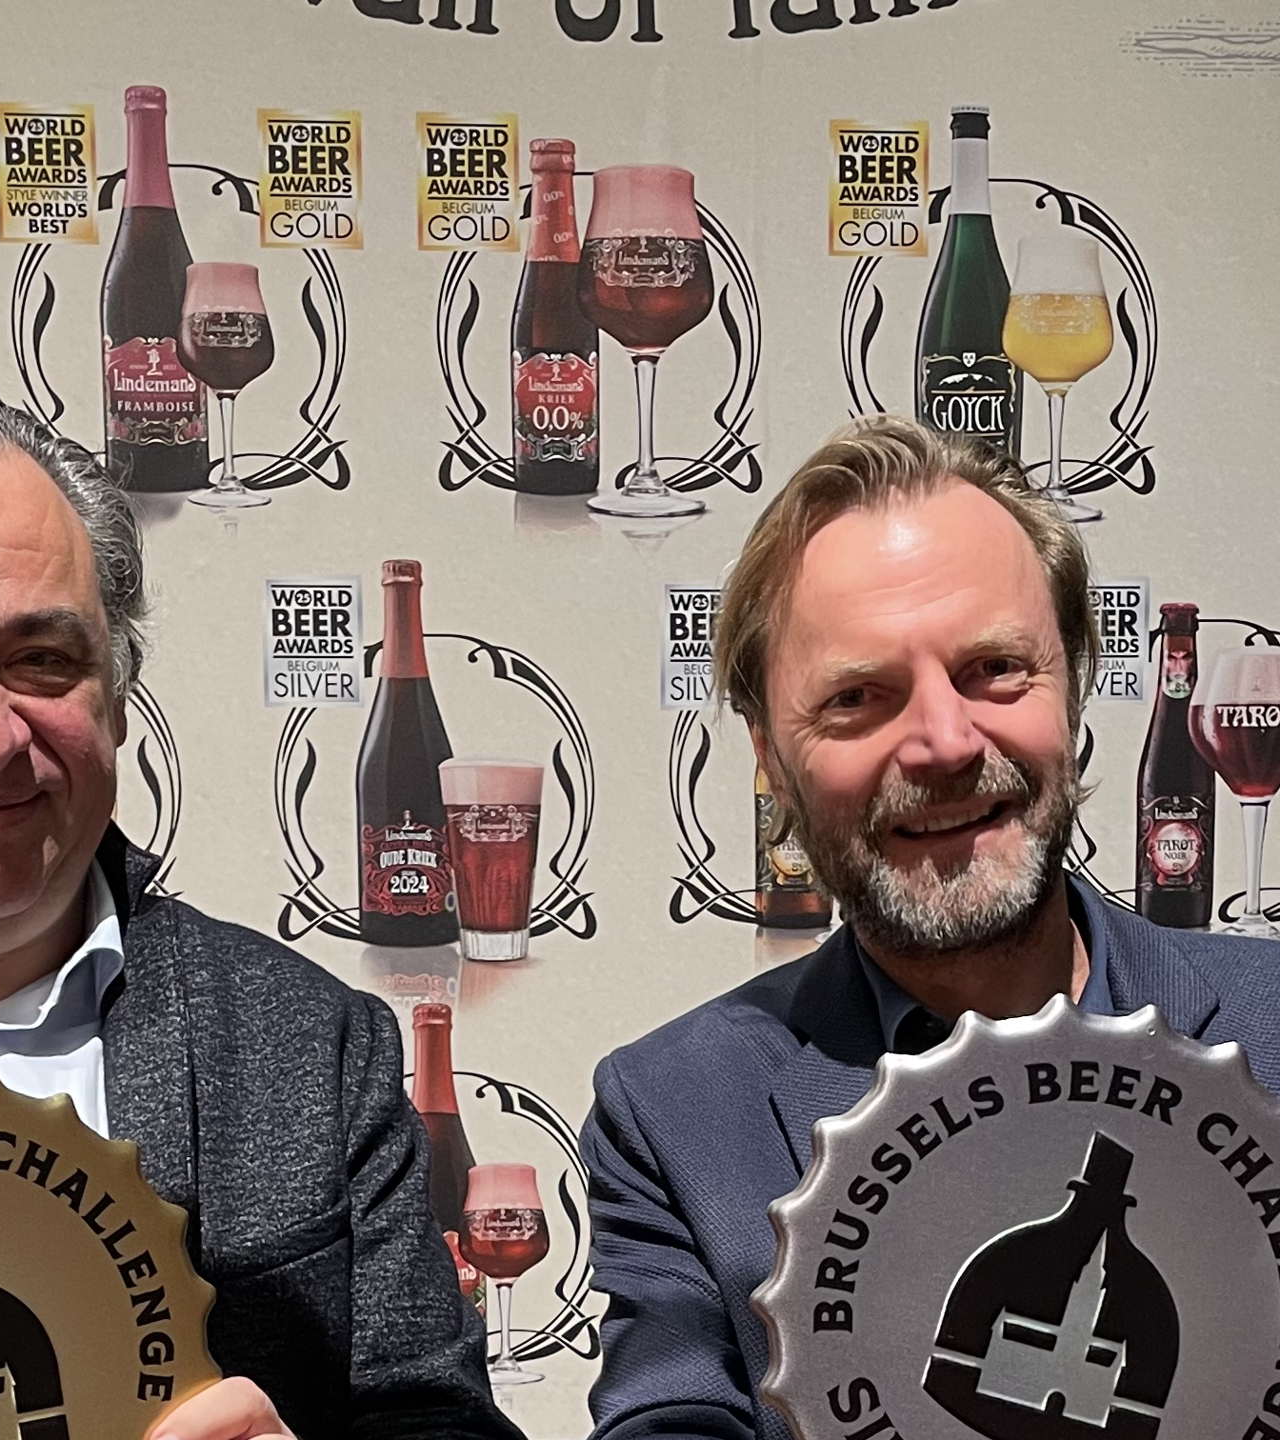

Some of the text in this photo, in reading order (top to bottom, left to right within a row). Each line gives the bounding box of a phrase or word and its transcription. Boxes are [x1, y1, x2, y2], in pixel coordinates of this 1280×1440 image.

[5, 118, 85, 136] WORLD
[268, 125, 351, 143] WORLD
[426, 128, 508, 146] WORLD
[840, 135, 919, 153] WORLD
[5, 137, 85, 166] BEER
[268, 145, 351, 175] BEER
[427, 148, 508, 178] BEER
[839, 155, 918, 184] BEER
[7, 168, 87, 183] AWARDS
[270, 176, 352, 193] AWARDS
[7, 190, 88, 202] STYLE WINNER
[427, 180, 509, 196] AWARDS
[839, 186, 919, 201] AWARDS
[8, 202, 87, 218] WORLD'S
[285, 200, 338, 211] BELGIUM
[442, 202, 496, 214] BELGIUM
[853, 208, 904, 219] BELGIUM
[29, 219, 69, 233] BEST
[270, 212, 353, 238] GOLD
[428, 215, 510, 241] GOLD
[839, 221, 918, 246] GOLD
[117, 401, 195, 412] FRAMBOISE
[932, 395, 1005, 432] GOYCK
[271, 589, 353, 607] WORLD
[670, 594, 721, 611] WOR
[1088, 591, 1140, 608] ORLD
[272, 608, 353, 637] BEER
[273, 639, 354, 654] AWARDS
[670, 642, 713, 657] AWA
[287, 660, 341, 672] BELGIUM
[684, 664, 713, 675] BELG
[274, 672, 355, 698] SILVER
[670, 676, 717, 701] SILV
[1095, 672, 1138, 696] VER
[390, 875, 430, 894] 2024
[813, 1075, 1005, 1334] BRUSSELS
[1024, 1060, 1184, 1126] BEER
